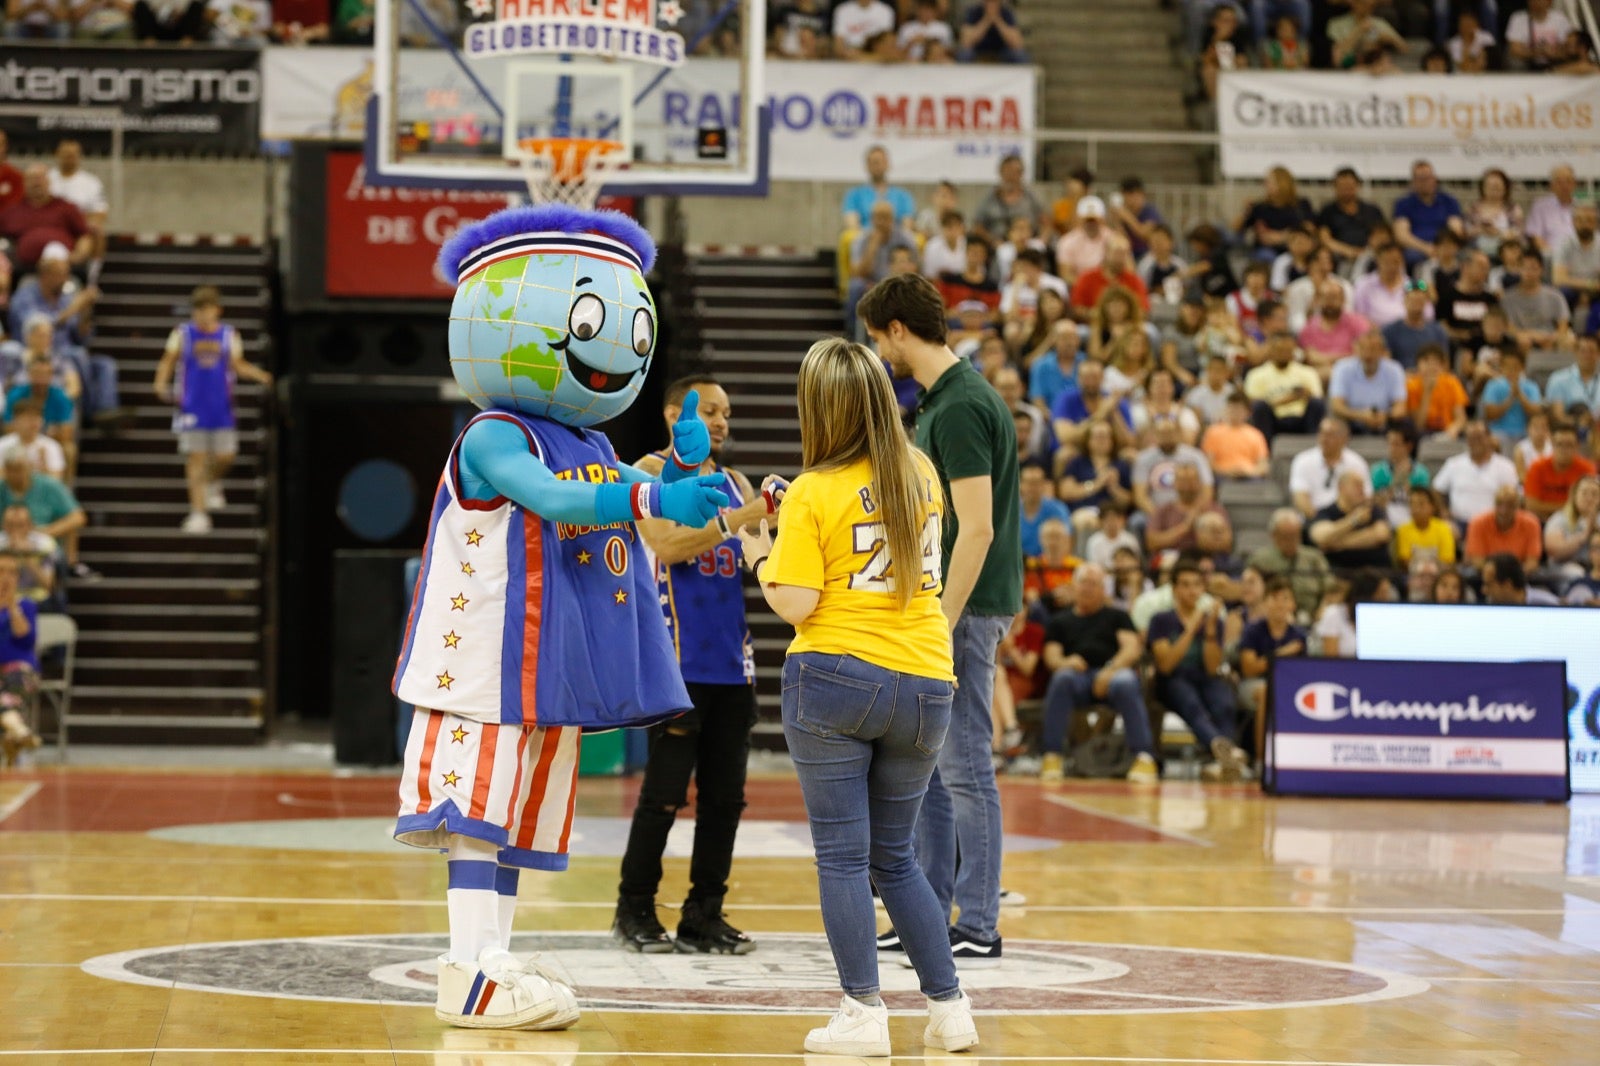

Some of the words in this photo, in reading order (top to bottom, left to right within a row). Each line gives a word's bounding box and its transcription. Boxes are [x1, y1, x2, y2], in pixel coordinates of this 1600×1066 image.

[502, 0, 650, 25] HARLEM
[471, 24, 678, 62] GLOBETROTTERS
[876, 97, 1021, 133] MARCA
[1234, 91, 1594, 138] GranadaDigital.es
[367, 213, 415, 244] DE
[604, 535, 628, 577] 0
[698, 545, 737, 578] 93
[1294, 681, 1537, 735] Champion
